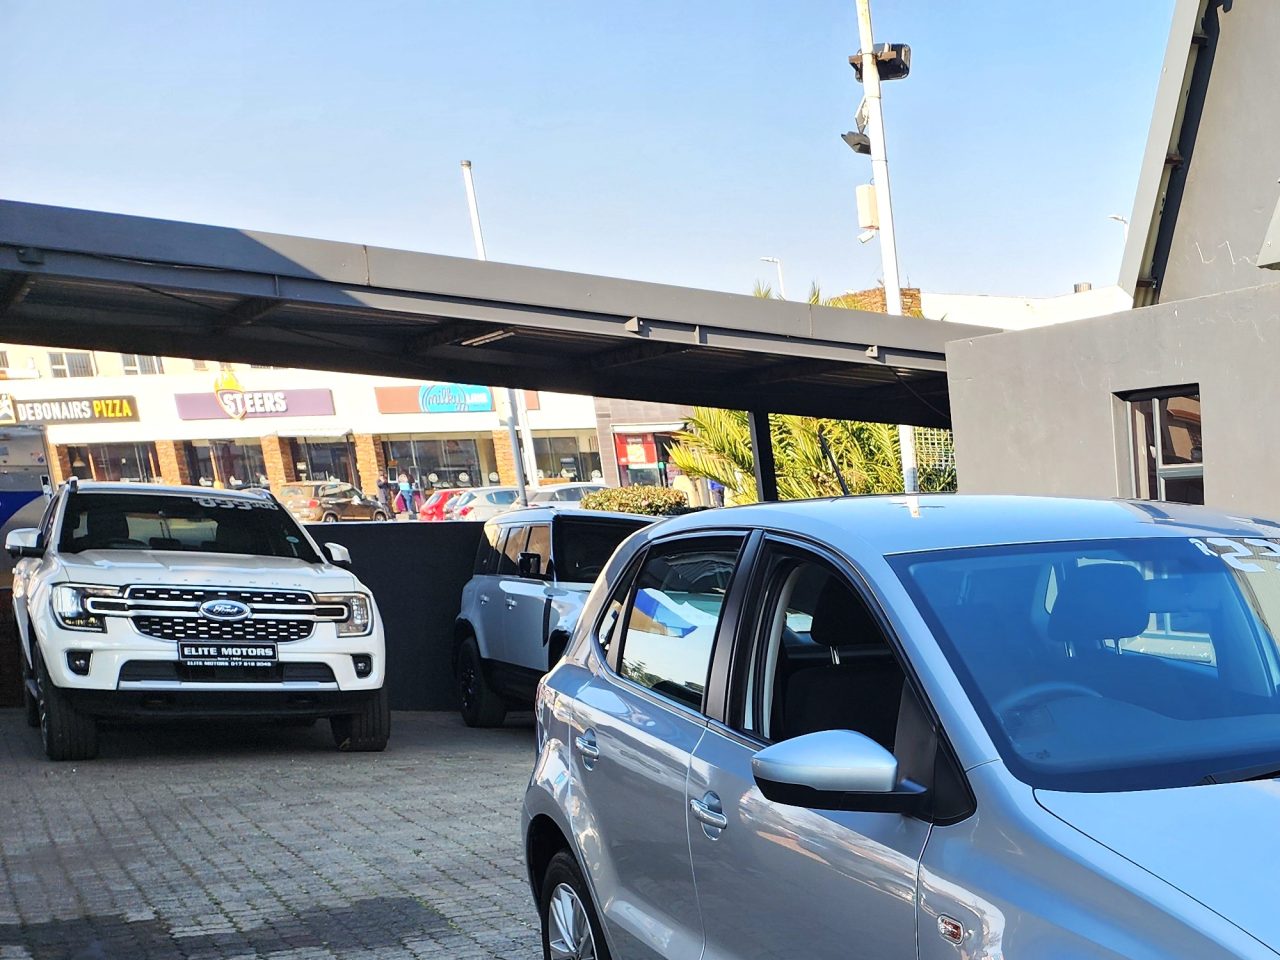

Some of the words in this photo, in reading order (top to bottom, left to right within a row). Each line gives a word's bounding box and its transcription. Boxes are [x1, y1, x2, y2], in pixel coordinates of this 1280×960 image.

[16, 401, 92, 421] DEBONAIRS
[92, 399, 133, 418] PIZZA
[222, 391, 288, 415] STEERS
[183, 647, 217, 656] ELITE
[221, 647, 273, 656] MOTORS
